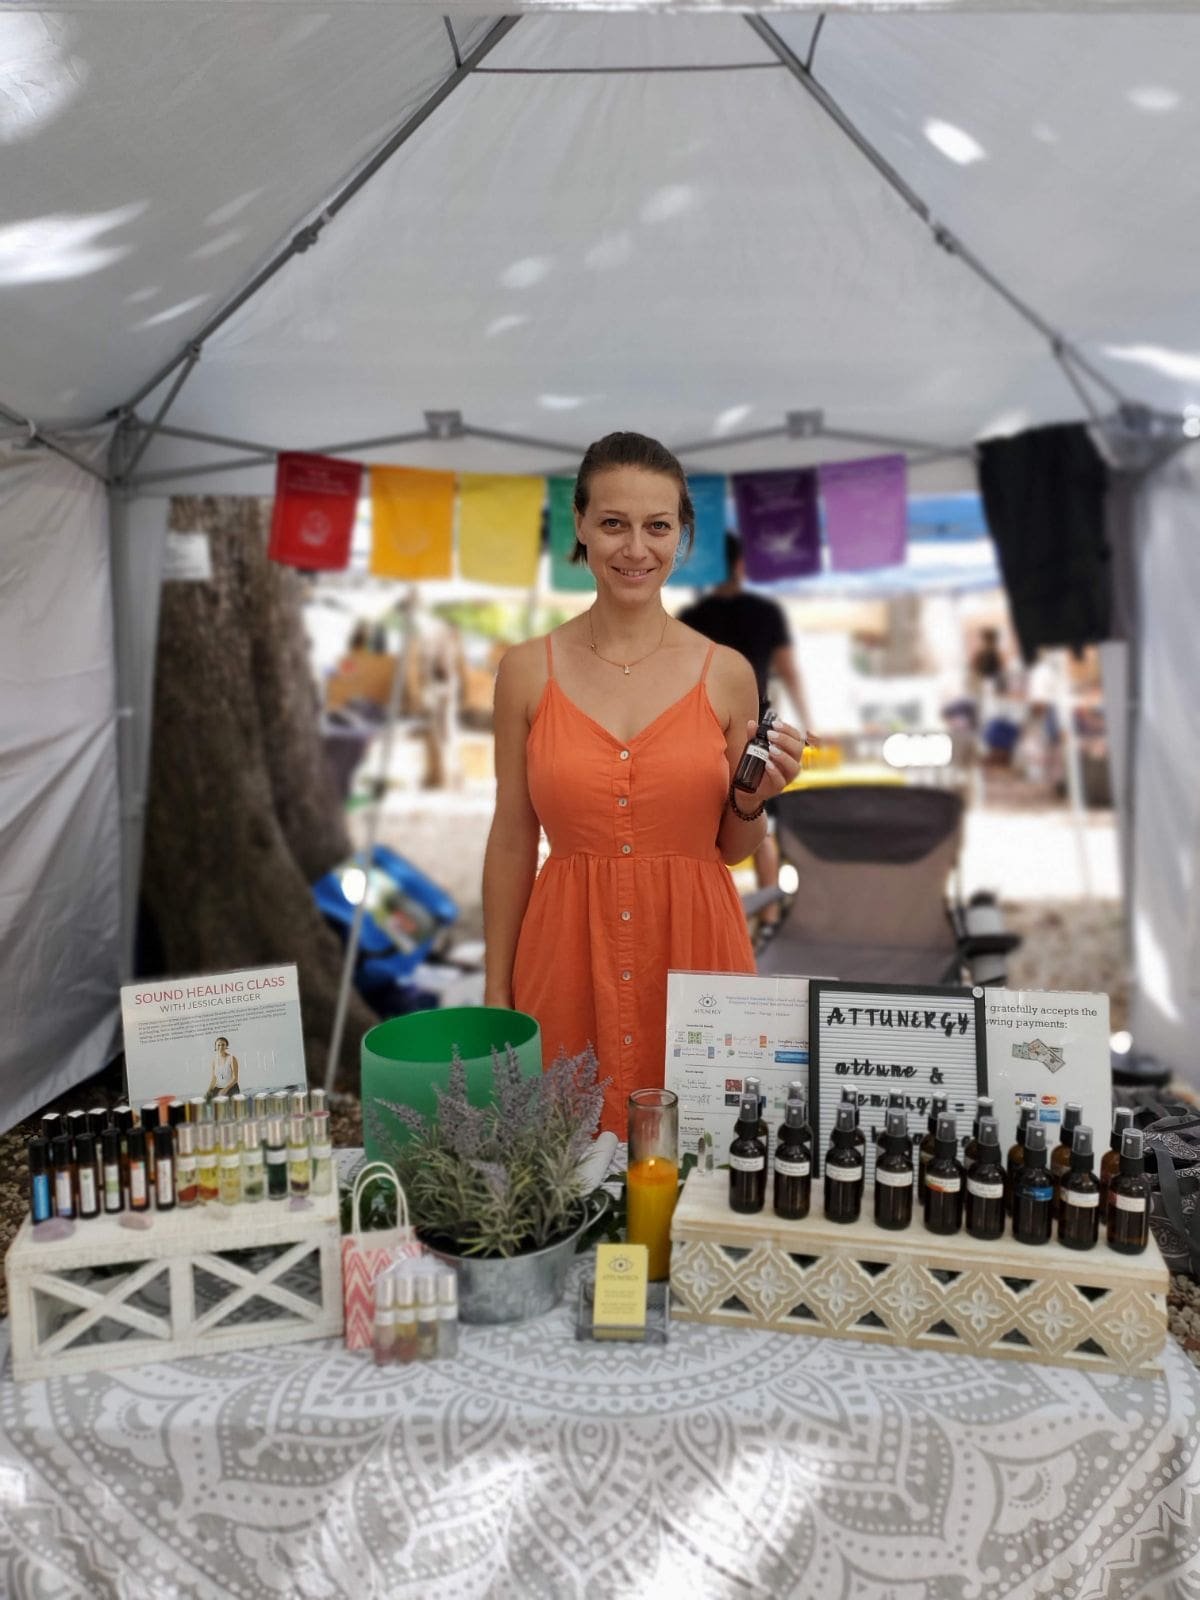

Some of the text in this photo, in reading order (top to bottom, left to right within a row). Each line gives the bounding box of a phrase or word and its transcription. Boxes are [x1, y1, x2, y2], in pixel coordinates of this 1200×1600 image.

[135, 976, 285, 1005] SOUND HEALING CLASS
[159, 993, 261, 1013] WITH JESSICA BERGER
[990, 1004, 1098, 1017] gratefully accepts the
[826, 1007, 970, 1037] ATTUNERGY
[1016, 1019, 1068, 1029] payments:
[834, 1058, 944, 1085] attune &
